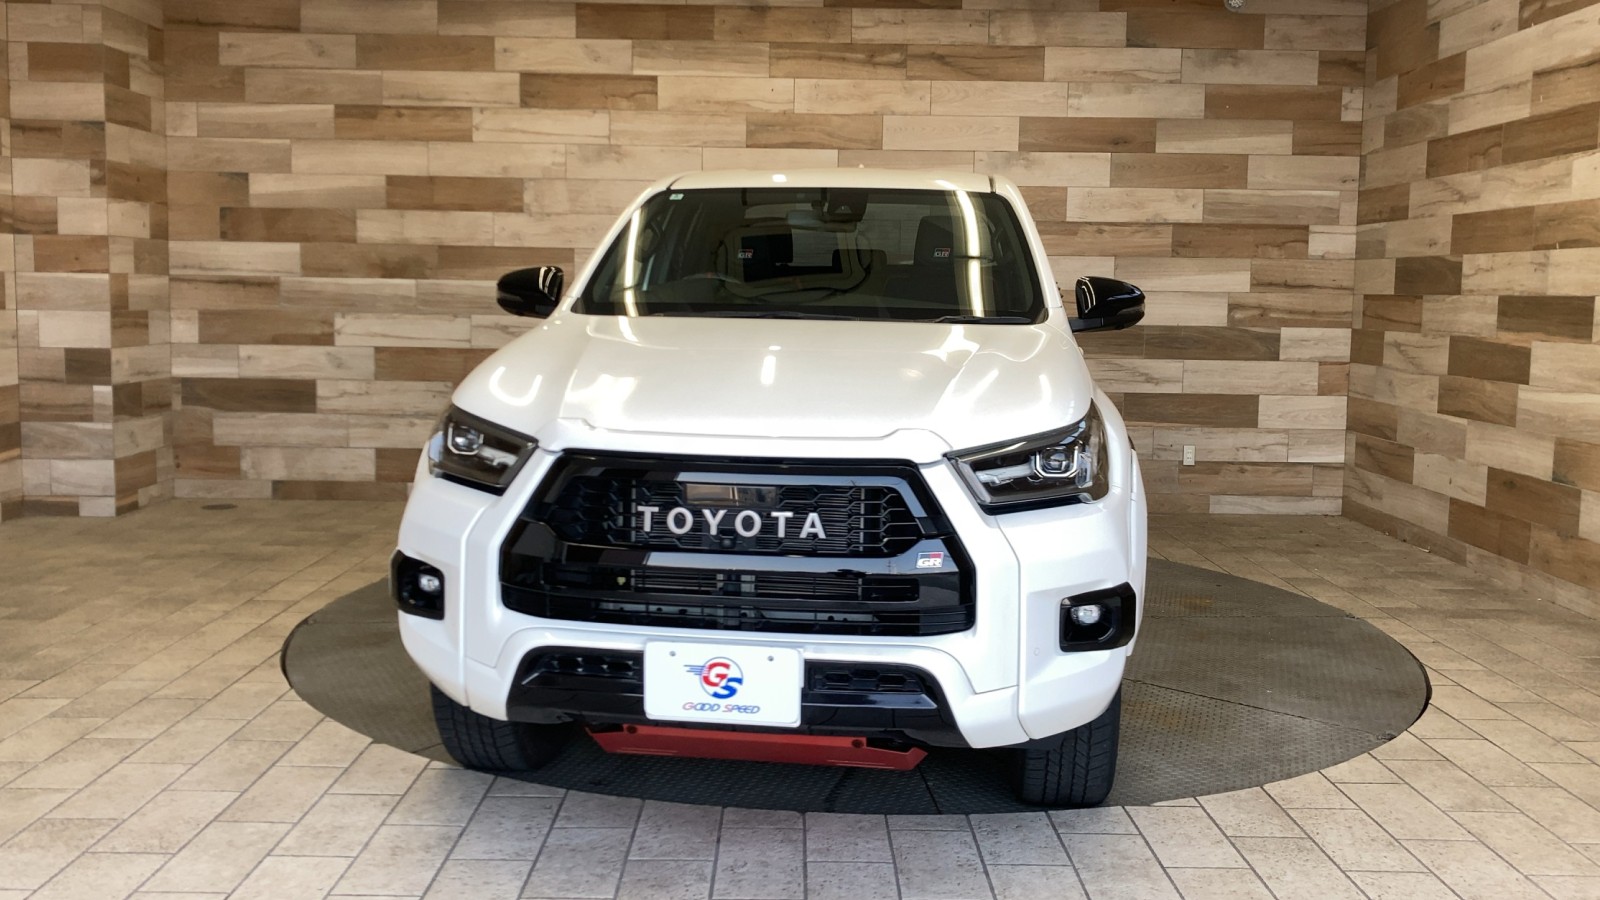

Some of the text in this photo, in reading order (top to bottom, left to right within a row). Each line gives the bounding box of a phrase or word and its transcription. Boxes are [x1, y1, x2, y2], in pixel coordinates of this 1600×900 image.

[637, 506, 826, 539] TOYOTA
[917, 557, 942, 568] GR
[702, 662, 743, 700] GS
[722, 704, 760, 714] SPEED
